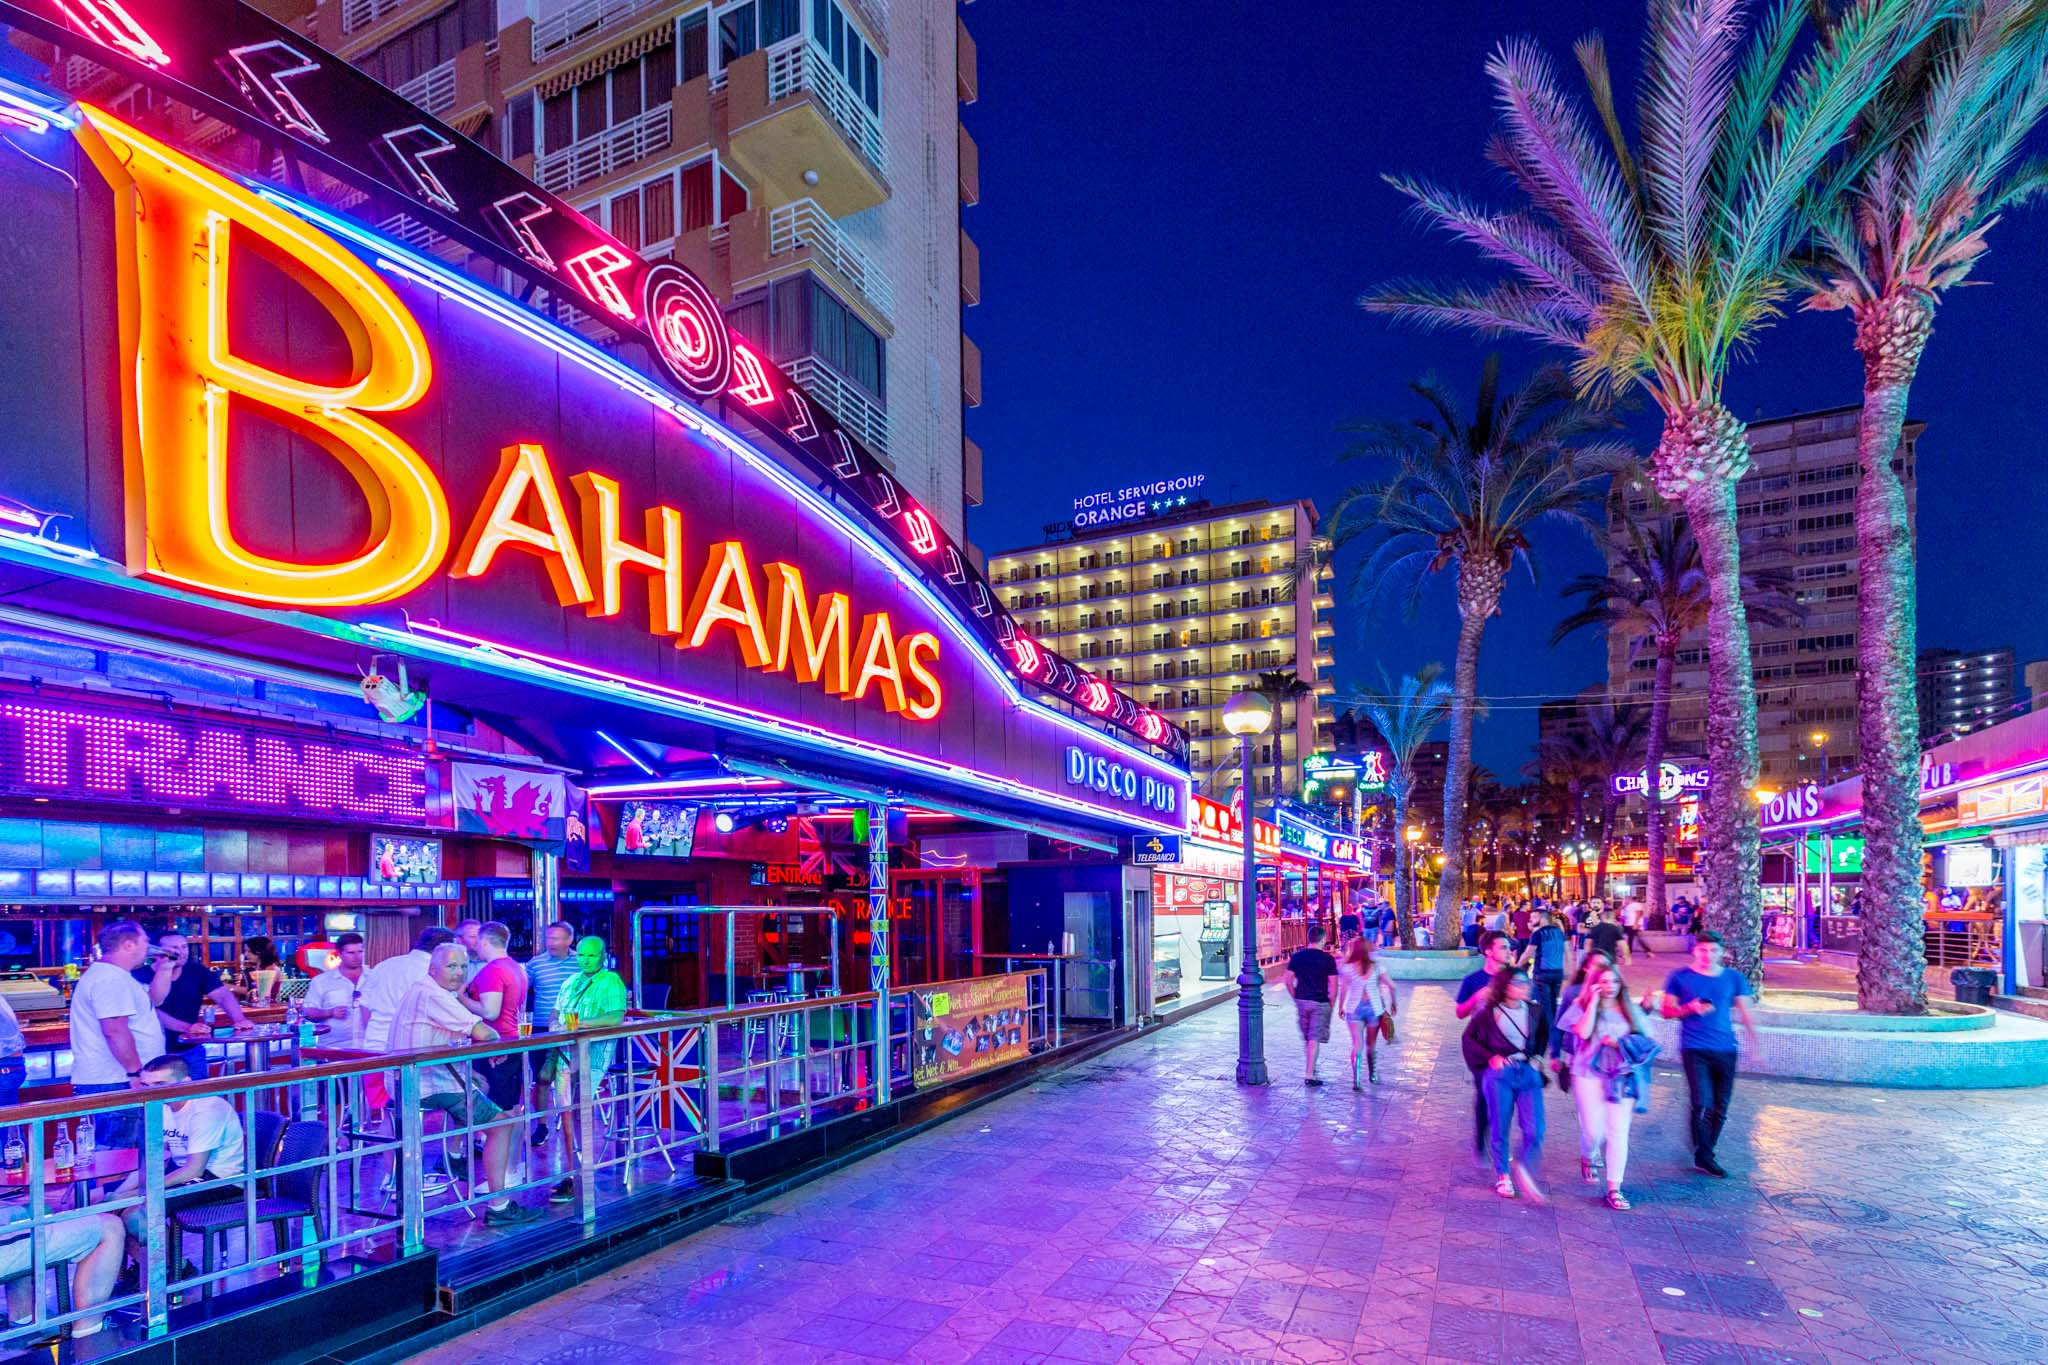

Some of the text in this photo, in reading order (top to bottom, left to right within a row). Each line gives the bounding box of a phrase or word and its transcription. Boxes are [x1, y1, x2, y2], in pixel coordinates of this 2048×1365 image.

[74, 101, 942, 721] BAHAMAS
[1074, 474, 1205, 510] HOTEL SERVIGROUP
[1074, 501, 1146, 526] ORANGE
[1066, 746, 1175, 813] DISCO PUB
[1137, 852, 1176, 862] TELEBANCO
